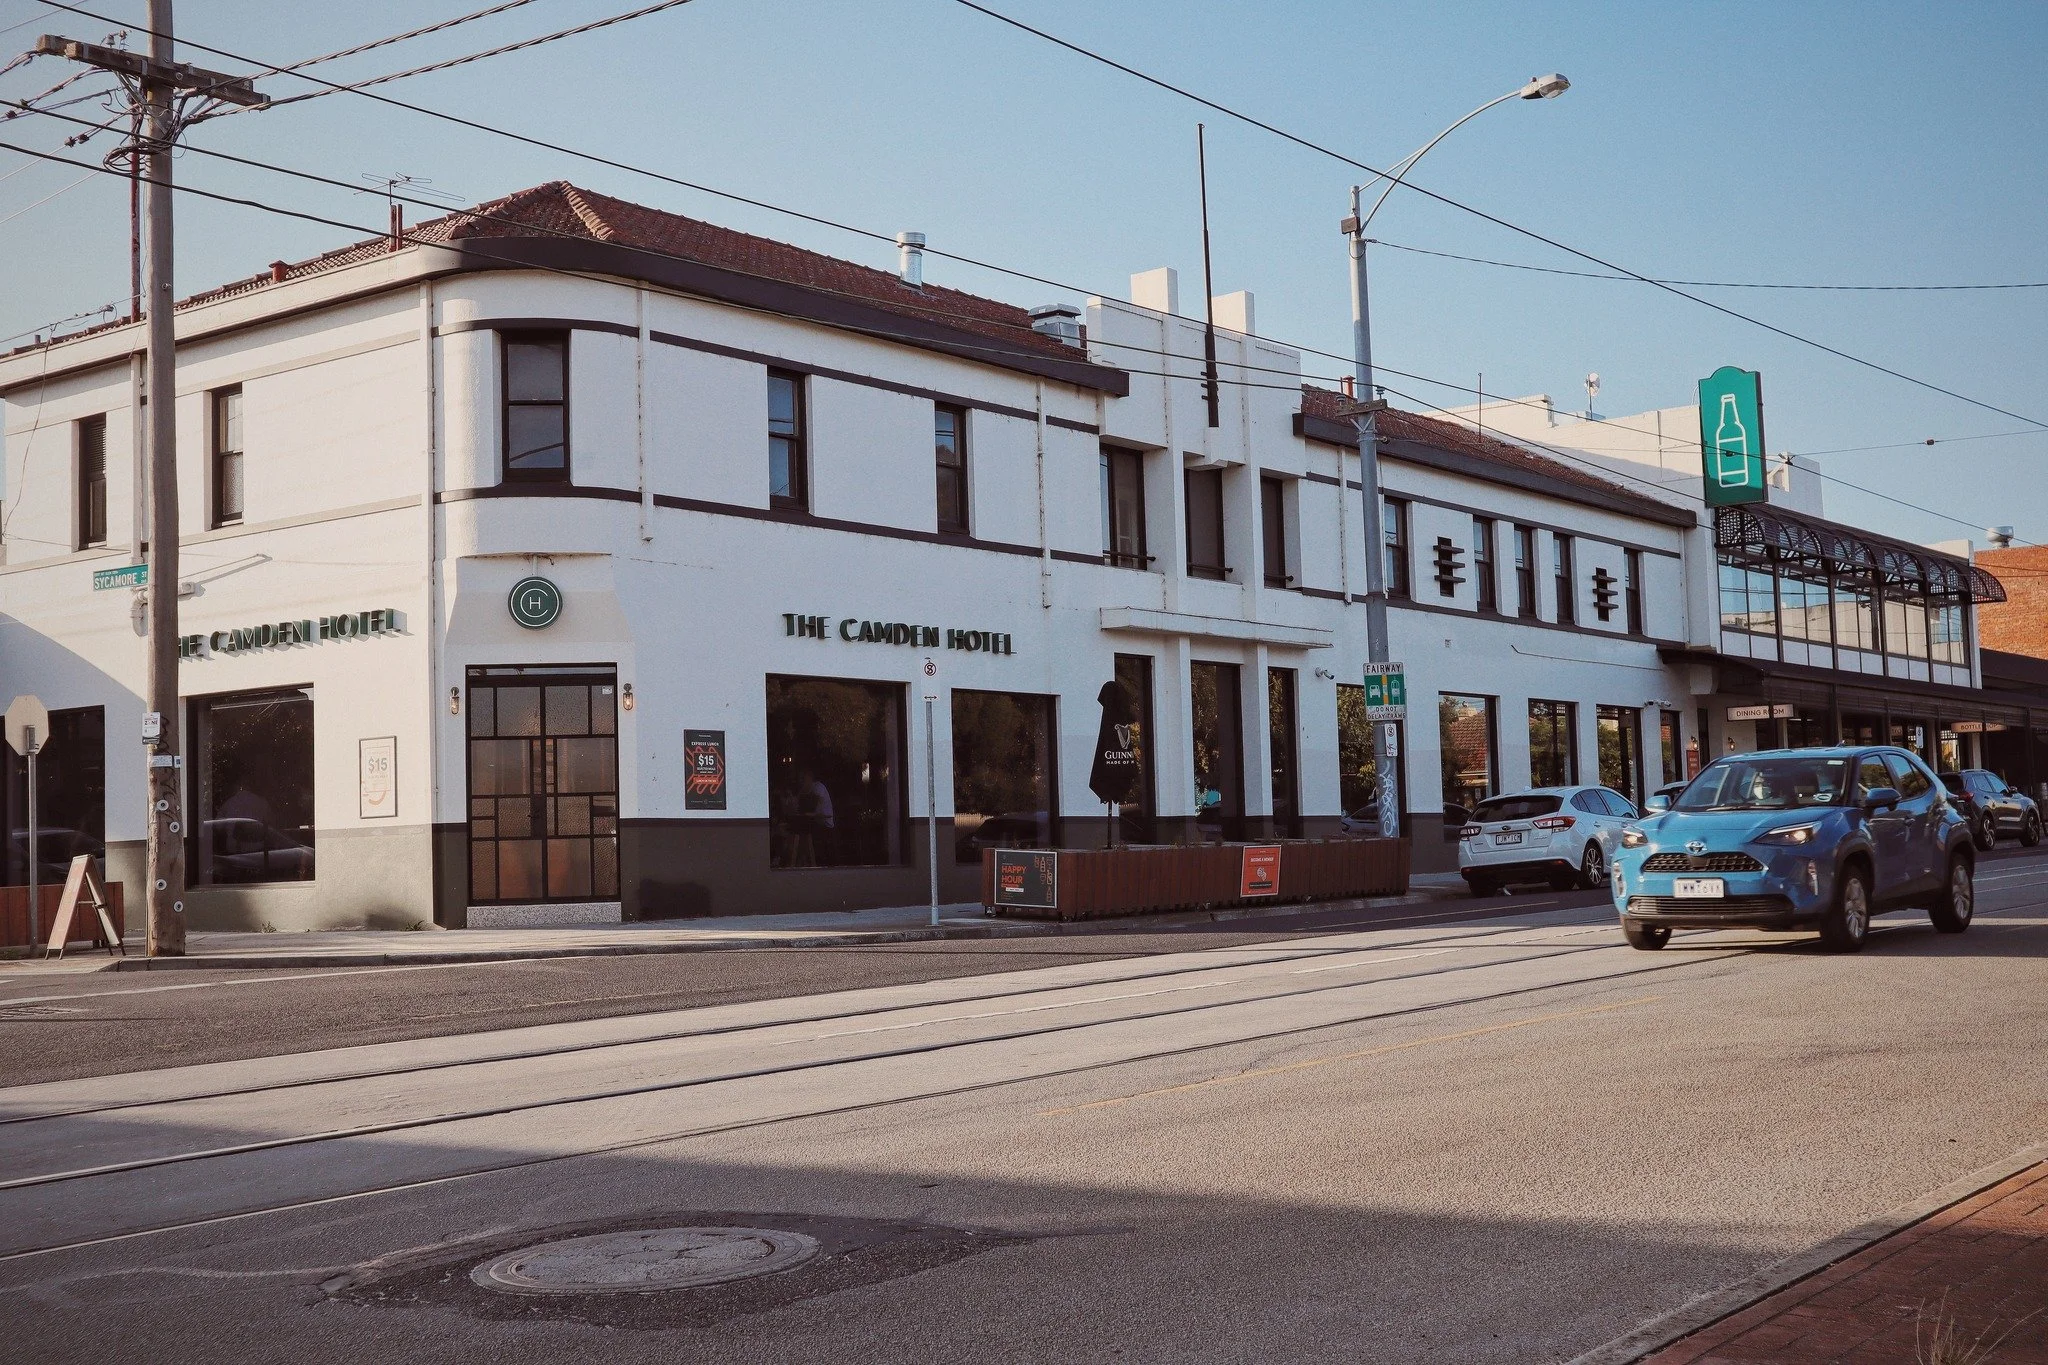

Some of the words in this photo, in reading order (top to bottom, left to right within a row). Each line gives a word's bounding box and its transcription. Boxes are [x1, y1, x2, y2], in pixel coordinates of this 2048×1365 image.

[95, 573, 137, 590] SYCAMORE
[178, 634, 204, 658] HE
[210, 619, 311, 652] CAMDEN
[319, 608, 402, 640] HOTEL
[782, 613, 832, 639] THE
[839, 618, 940, 648] CAMDEN
[947, 628, 1018, 656] HOTEL
[1367, 664, 1401, 673] FAIRWAY
[1736, 709, 1762, 717] DINING
[368, 755, 388, 774] $15
[698, 753, 715, 767] $15
[1001, 865, 1026, 874] HAPPY
[1001, 875, 1023, 884] HOUR
